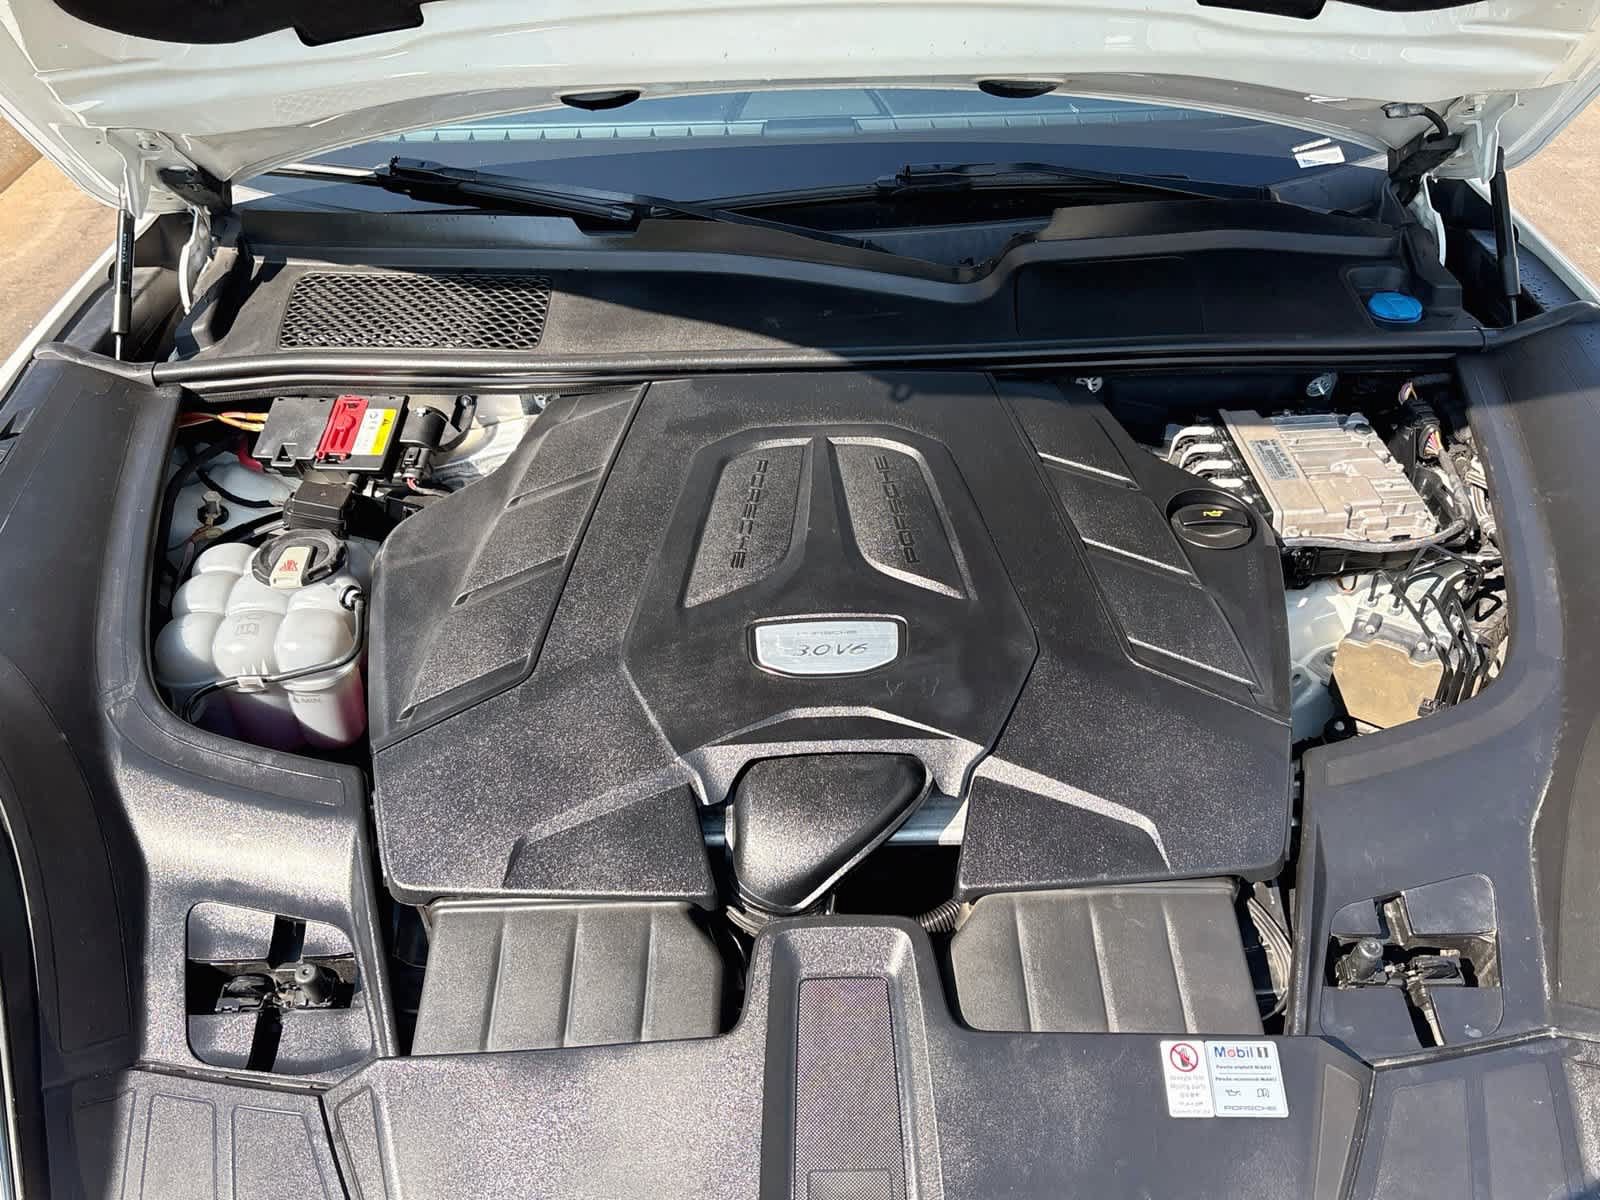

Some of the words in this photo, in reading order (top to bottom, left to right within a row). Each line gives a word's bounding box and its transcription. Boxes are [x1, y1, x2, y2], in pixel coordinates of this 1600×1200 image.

[729, 458, 769, 569] PORSCHE
[873, 454, 920, 564] PORSCHE
[1213, 1045, 1254, 1059] Mobil
[1223, 1104, 1278, 1112] PORSCHE
